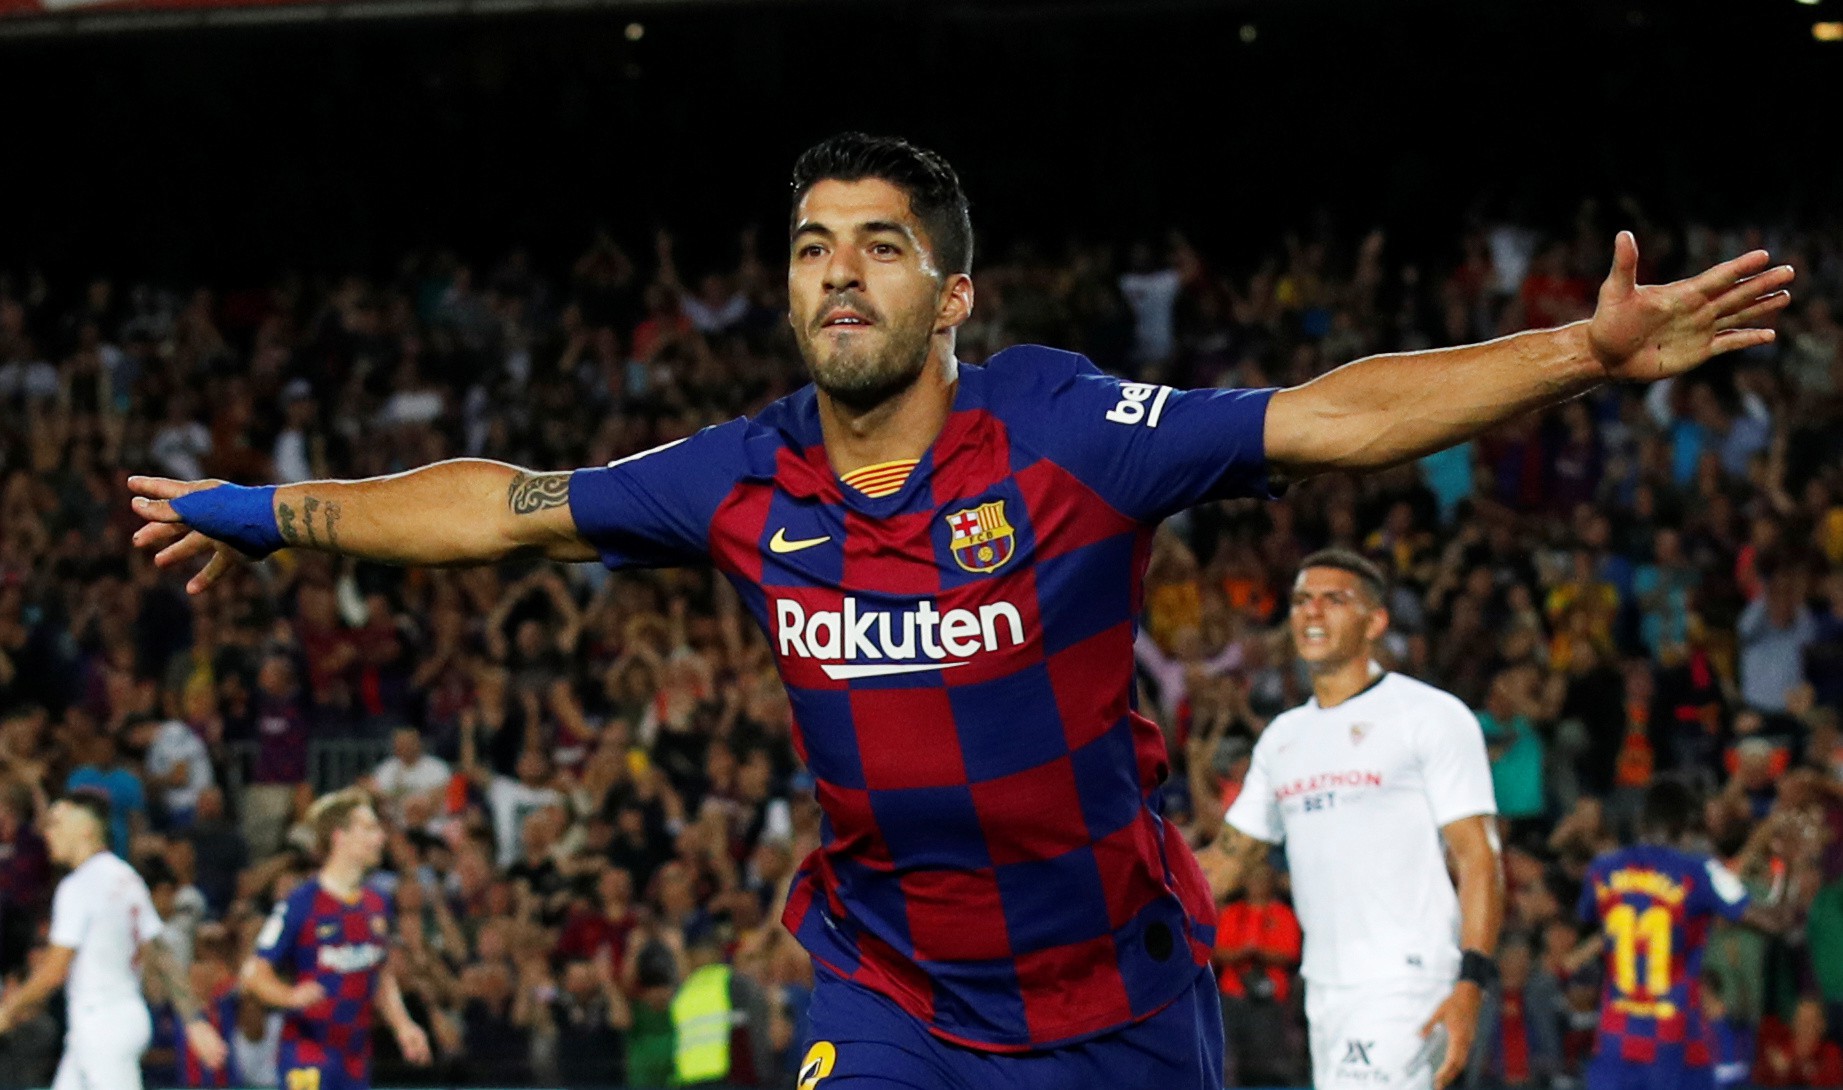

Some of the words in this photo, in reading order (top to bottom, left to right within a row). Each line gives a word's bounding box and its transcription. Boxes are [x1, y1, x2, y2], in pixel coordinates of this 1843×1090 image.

[776, 597, 1025, 660] Rakuten
[1304, 791, 1335, 812] BET
[1605, 904, 1671, 996] 11
